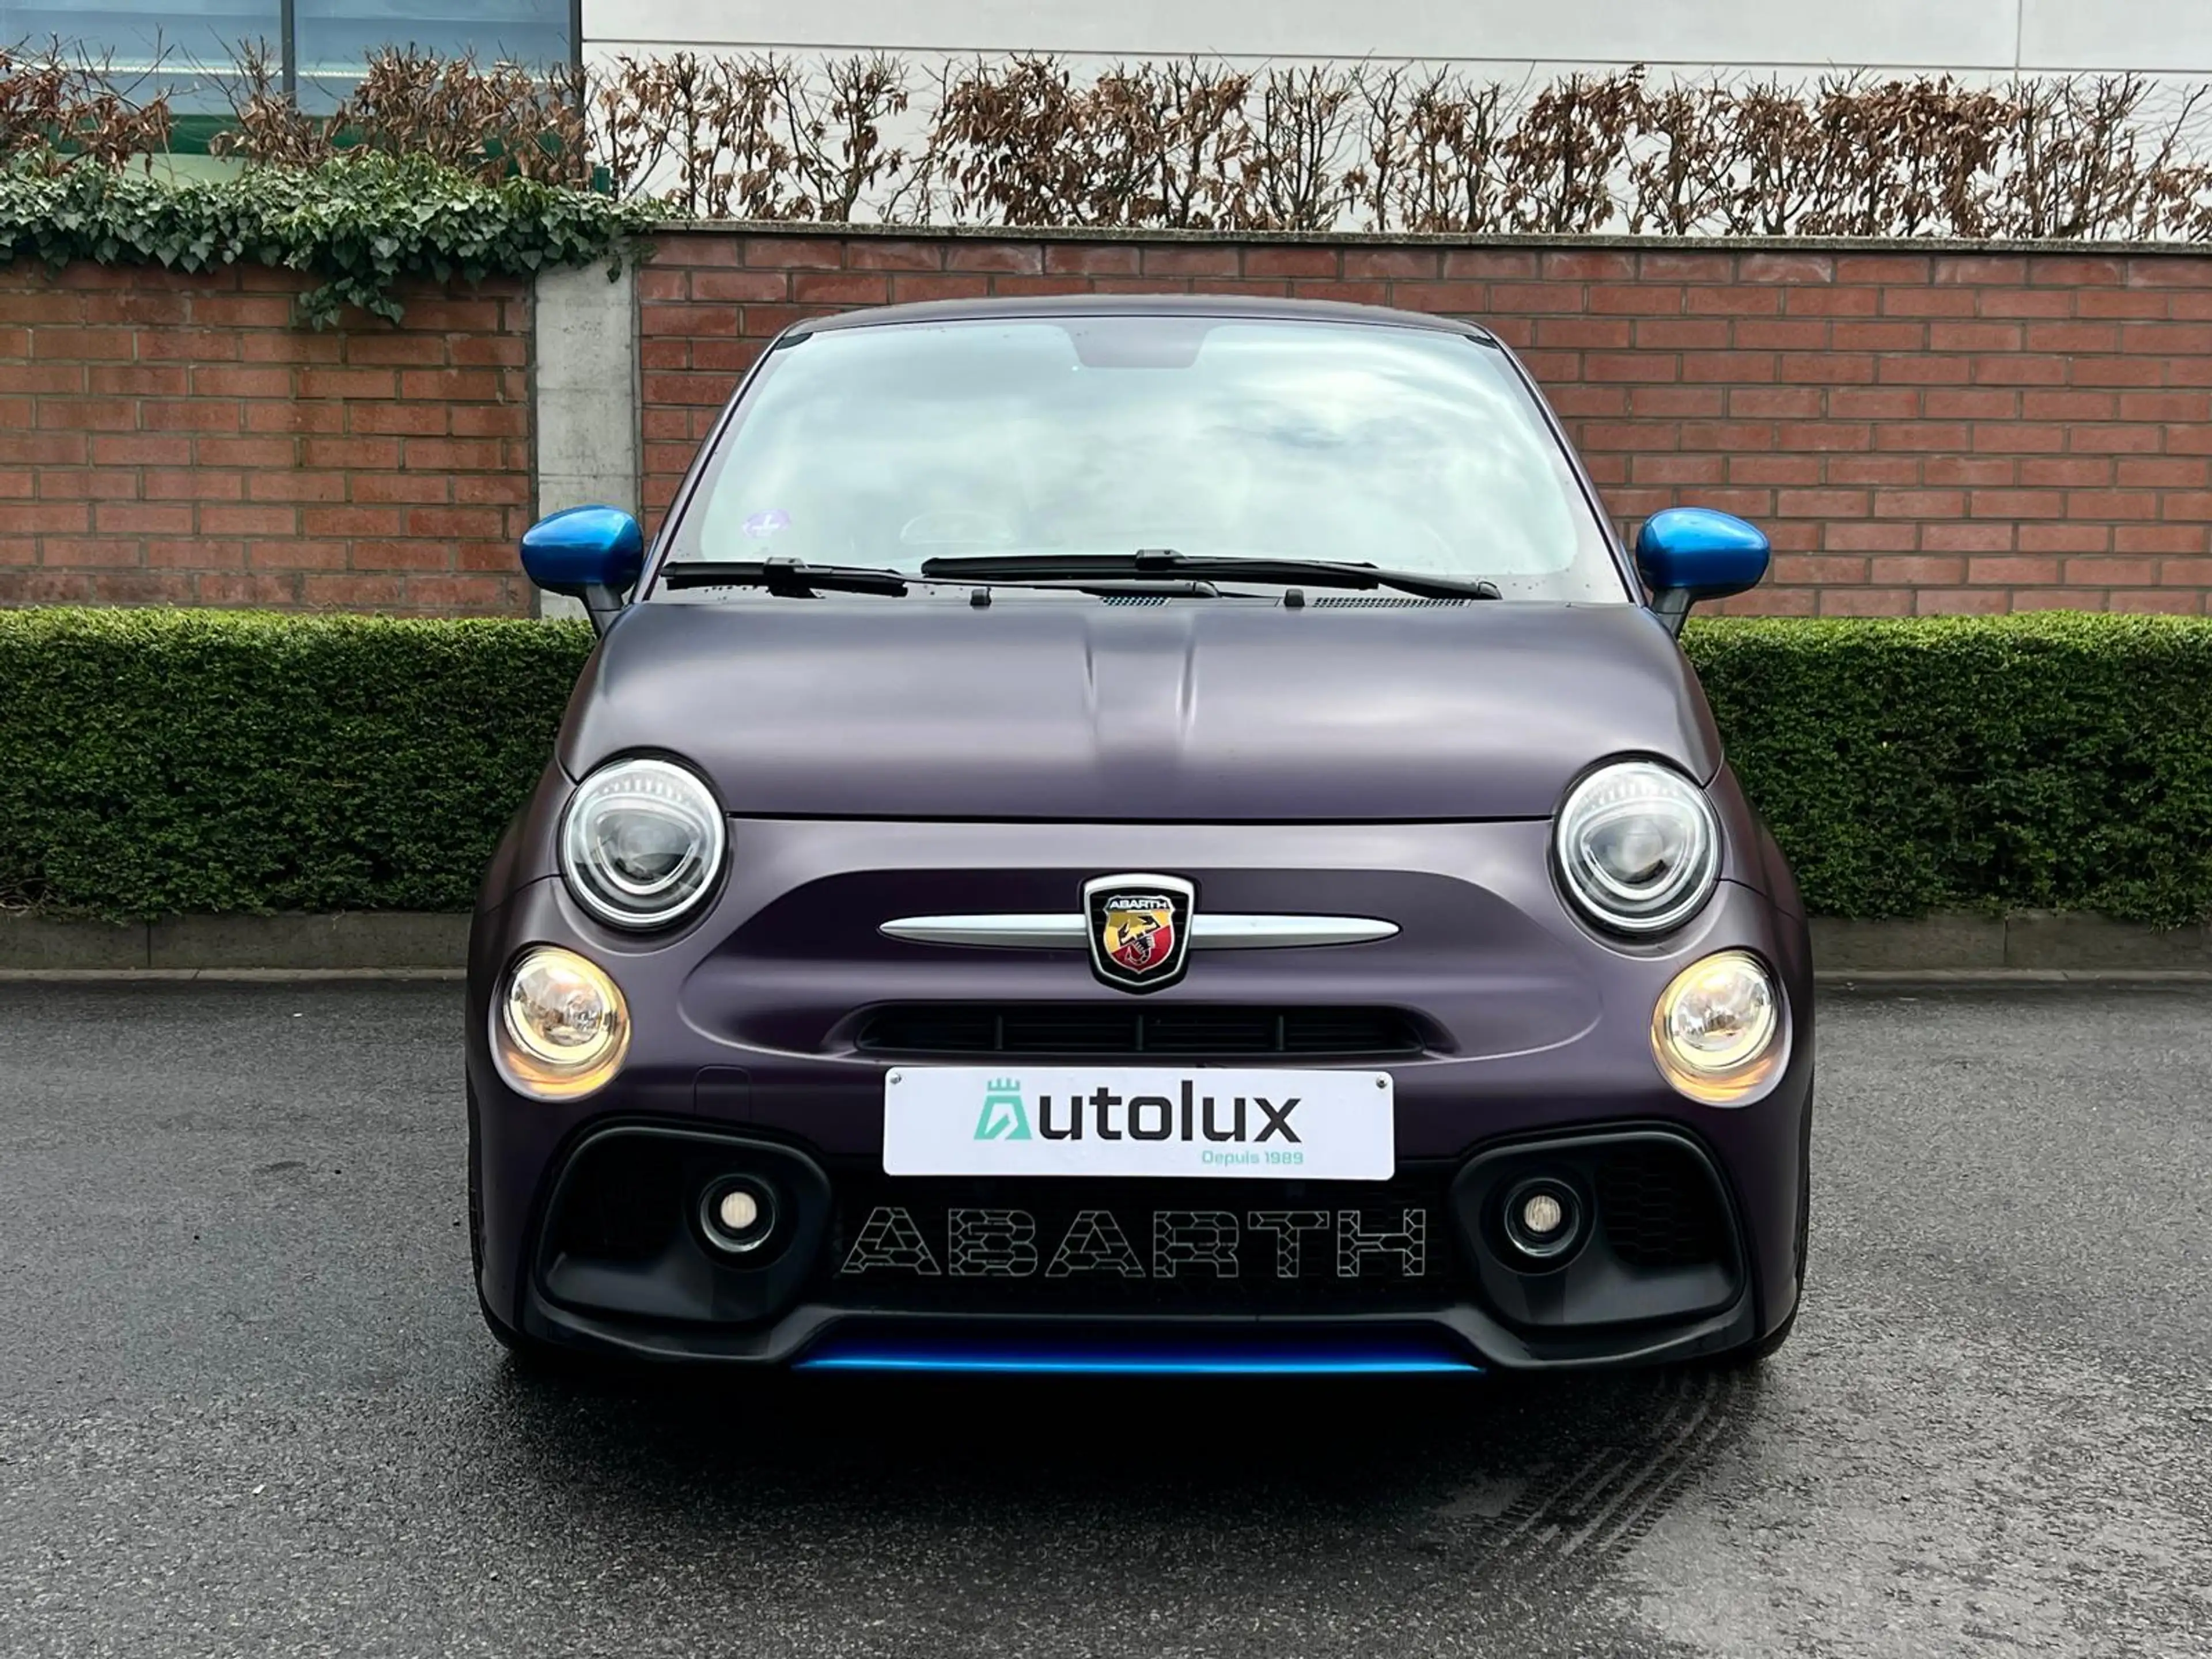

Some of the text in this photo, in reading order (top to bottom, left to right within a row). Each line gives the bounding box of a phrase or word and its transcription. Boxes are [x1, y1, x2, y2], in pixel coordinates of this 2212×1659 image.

[1110, 900, 1166, 909] ABARTH
[1202, 1150, 1304, 1166] Depuis 1989
[840, 1207, 1426, 1277] ABARTH
